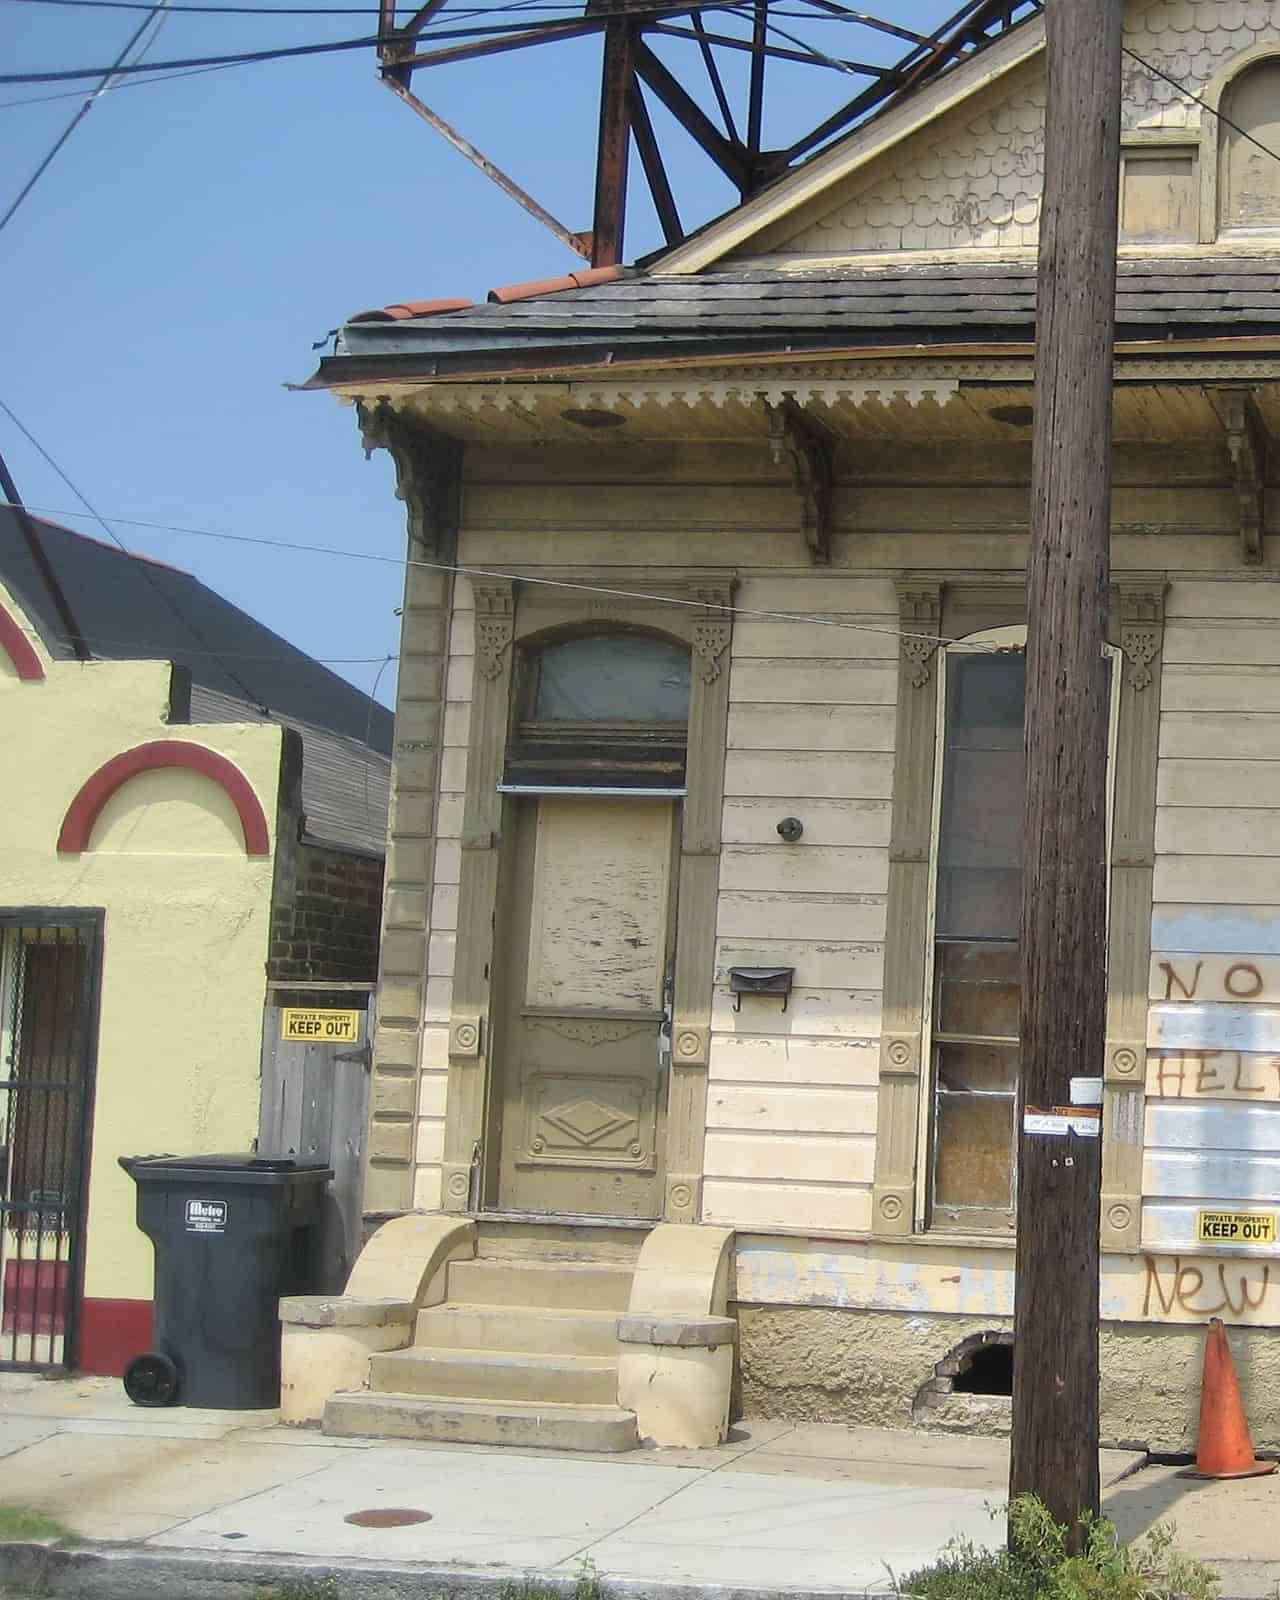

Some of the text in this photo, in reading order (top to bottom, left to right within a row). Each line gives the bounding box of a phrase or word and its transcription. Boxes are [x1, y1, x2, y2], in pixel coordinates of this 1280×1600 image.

[289, 1021, 351, 1036] KEEP OUT
[1203, 1214, 1270, 1224] PRIVATE PROPERTY
[1202, 1222, 1270, 1239] KEEP OUT
